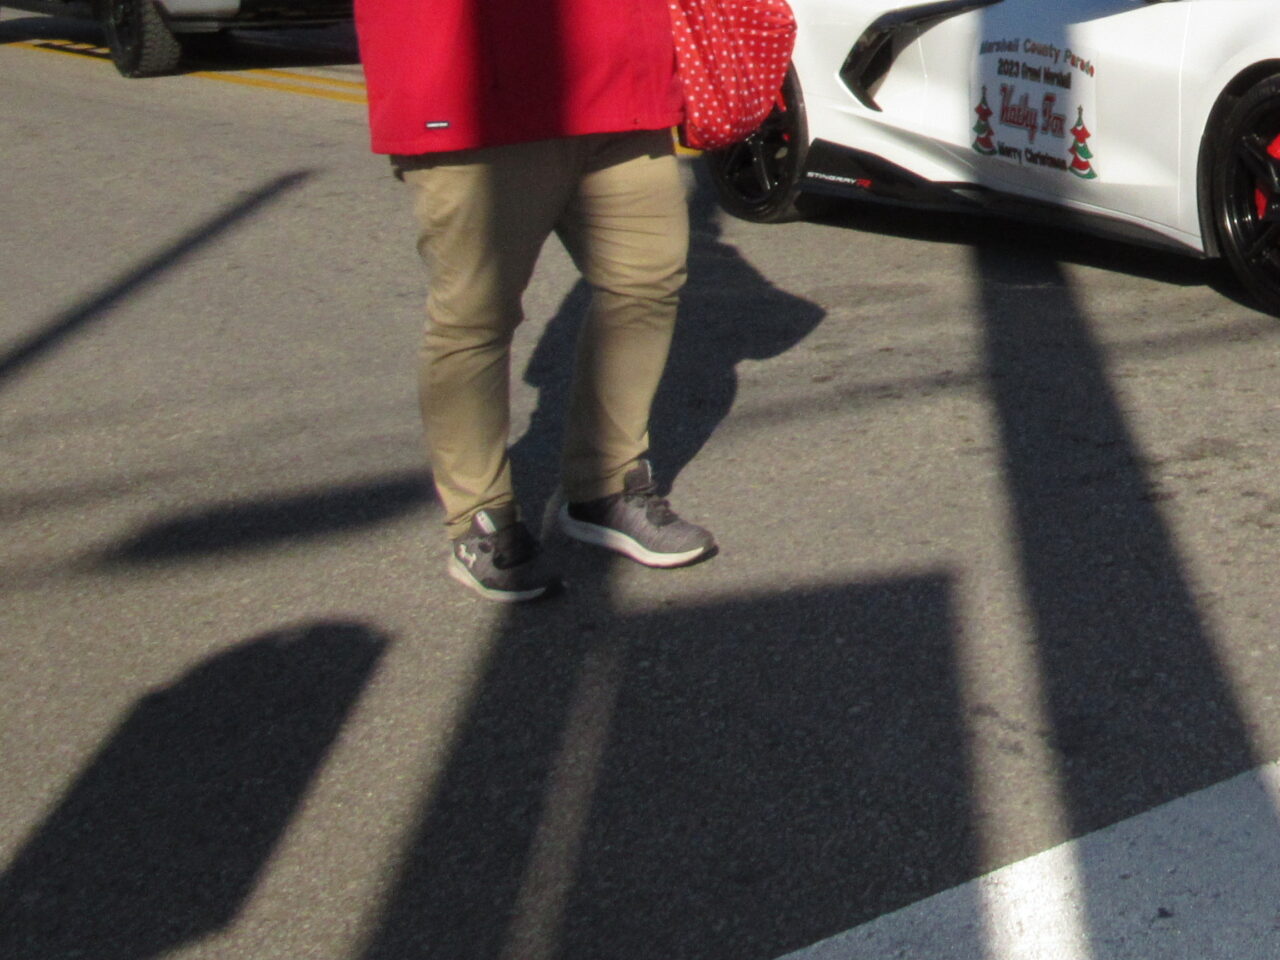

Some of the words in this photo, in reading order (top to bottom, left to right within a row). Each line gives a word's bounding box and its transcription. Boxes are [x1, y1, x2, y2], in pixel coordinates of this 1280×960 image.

[997, 58, 1020, 78] 2023
[1023, 38, 1061, 64] County
[1063, 48, 1095, 77] Parade
[997, 141, 1022, 165] Merry
[1024, 147, 1068, 172] Christmas
